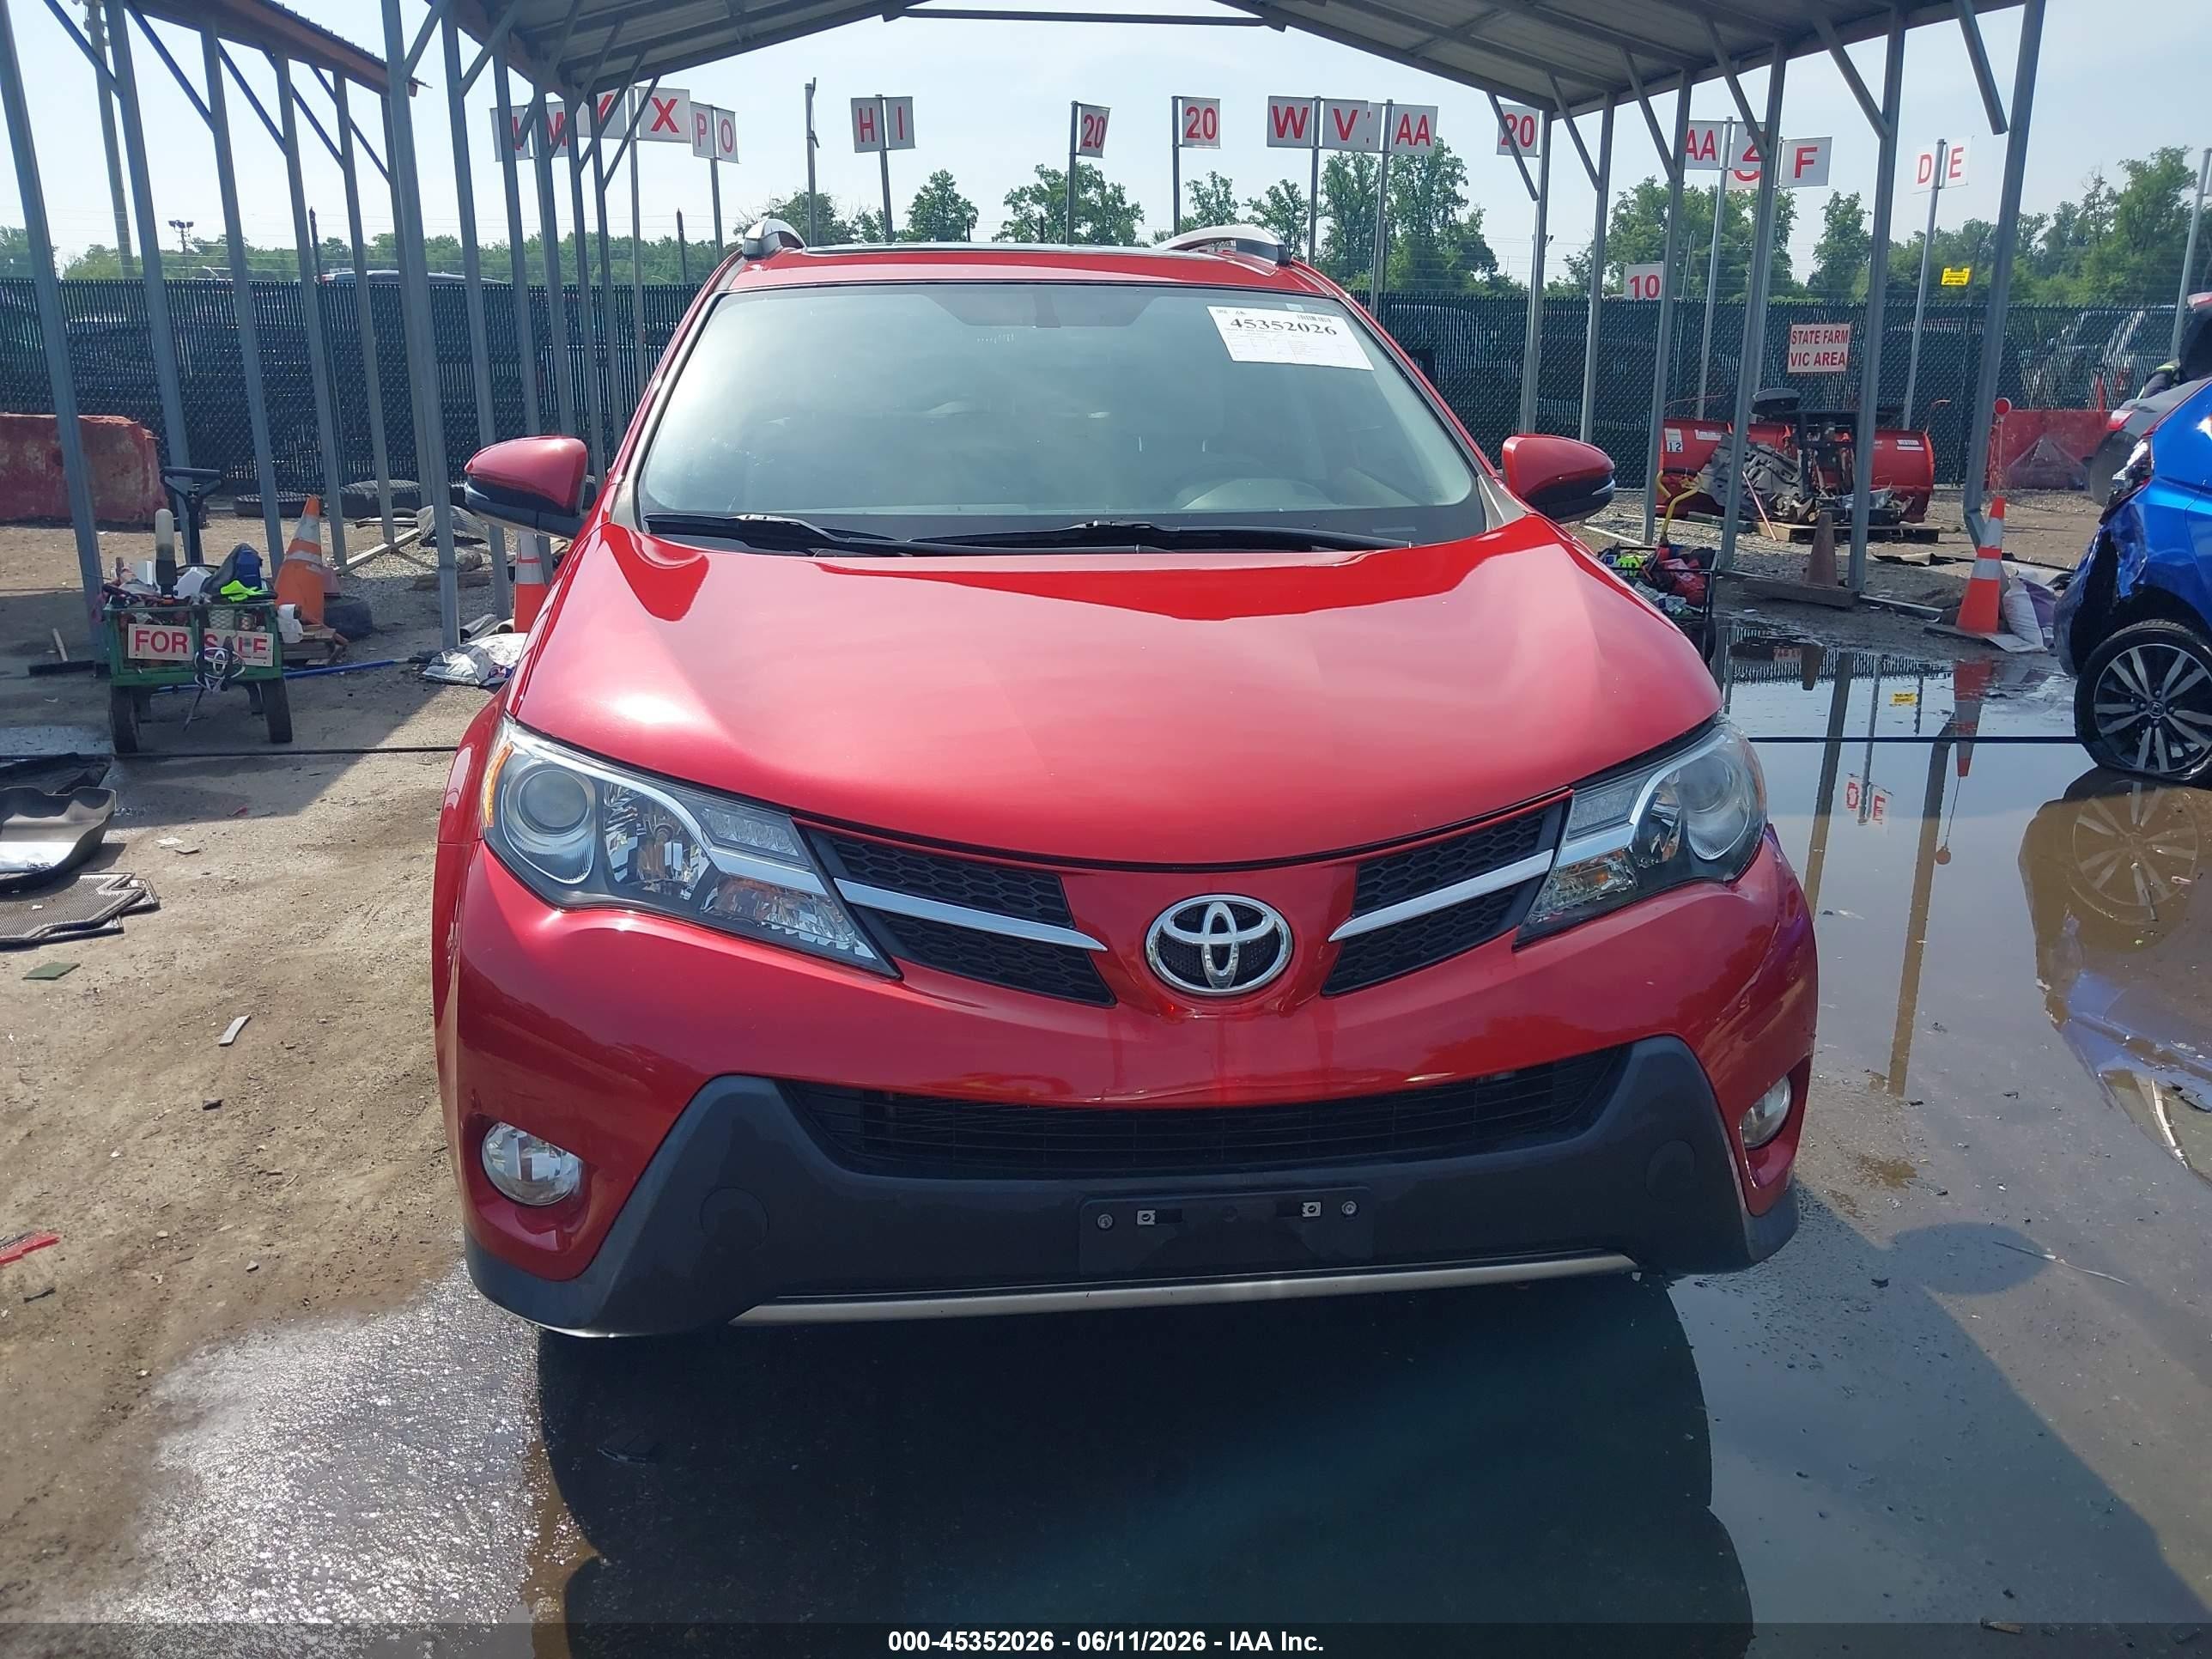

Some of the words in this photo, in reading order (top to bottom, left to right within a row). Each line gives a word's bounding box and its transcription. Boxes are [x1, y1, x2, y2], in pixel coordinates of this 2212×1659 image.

[650, 97, 679, 133] X
[696, 112, 707, 148] P
[859, 107, 875, 143] H
[898, 106, 904, 140] I
[1082, 114, 1106, 149] 20
[1186, 106, 1217, 140] 20
[1272, 106, 1309, 139] W
[1333, 108, 1358, 142] V
[1395, 113, 1431, 147] AA
[1501, 113, 1535, 147] 20
[720, 118, 733, 153] O
[1686, 129, 1717, 161] AA
[1795, 147, 1818, 179] F
[1917, 154, 1932, 184] D
[1948, 147, 1964, 178] E
[1630, 274, 1660, 299] 10
[1231, 319, 1338, 336] 45352026
[1791, 330, 1820, 344] STATE
[1823, 330, 1849, 344] FARM
[1790, 352, 1810, 367] VIC
[1814, 352, 1845, 367] AREA
[135, 630, 188, 653] FOR
